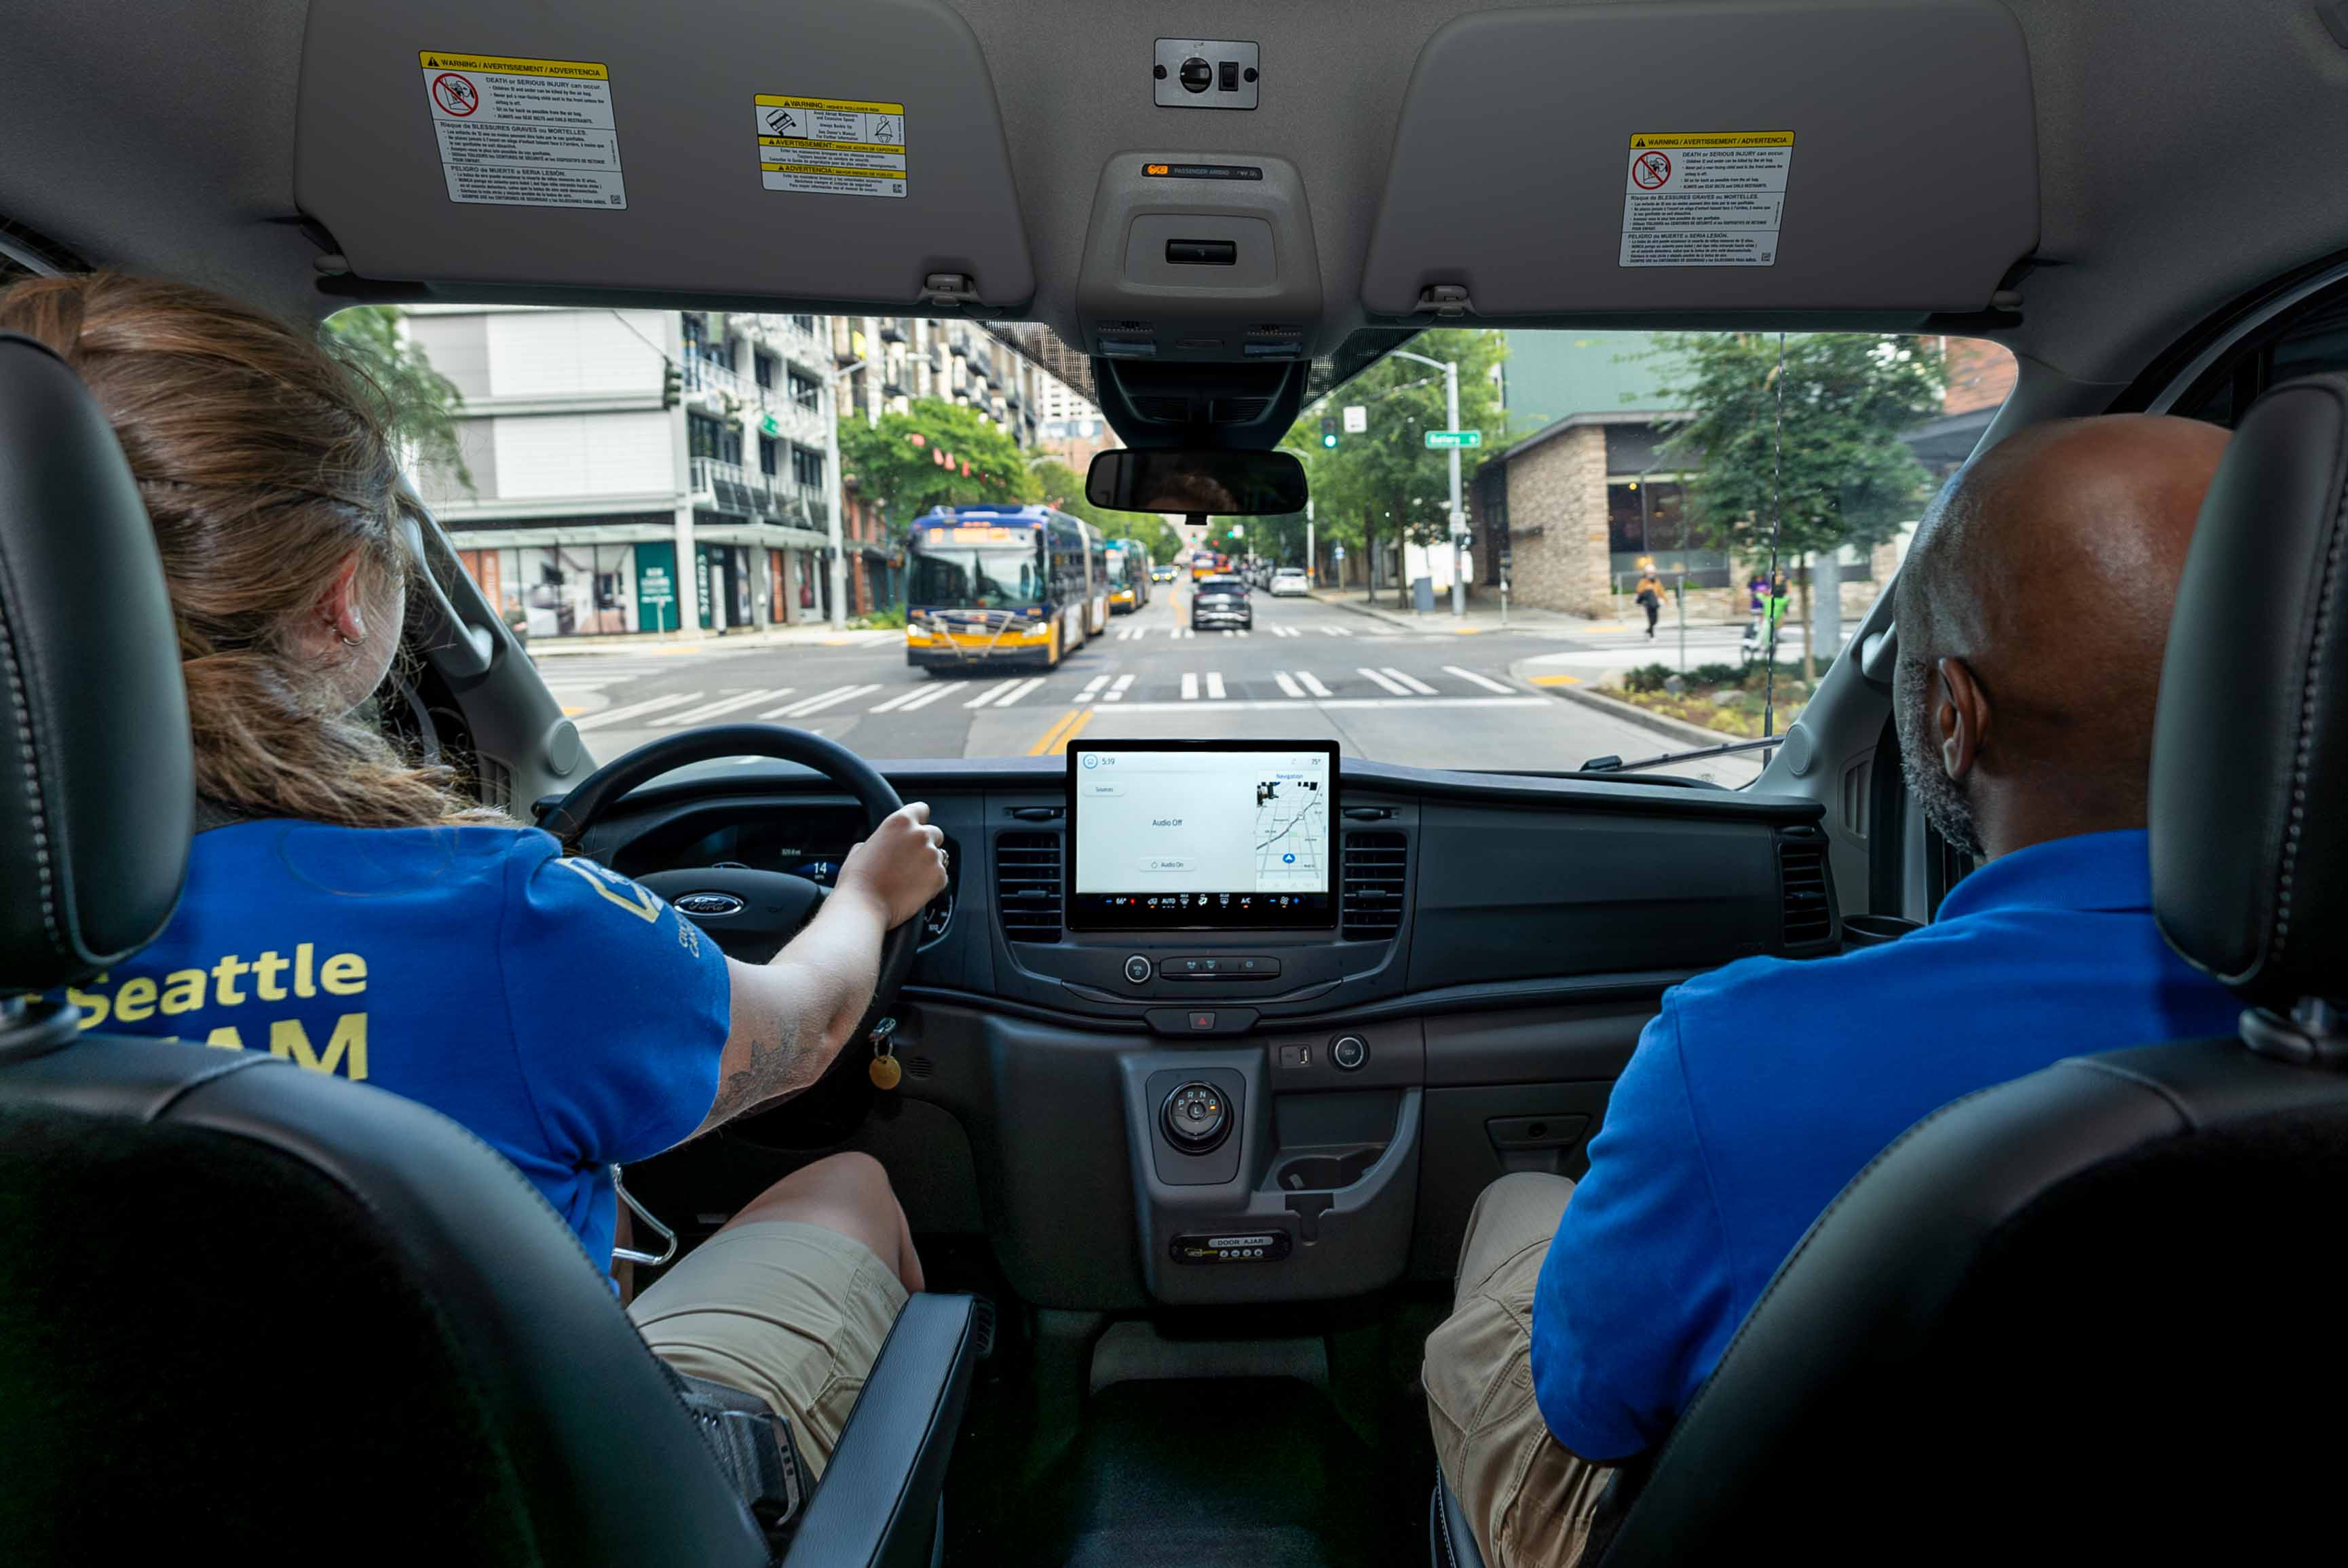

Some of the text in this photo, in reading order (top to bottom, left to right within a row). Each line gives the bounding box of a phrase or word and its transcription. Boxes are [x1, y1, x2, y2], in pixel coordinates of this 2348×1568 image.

[441, 59, 477, 69] WARNING
[483, 62, 543, 73] AVERTISSEMENT
[550, 66, 601, 76] ADVERTENCIA
[814, 862, 827, 874] 14
[67, 942, 367, 1031] Seattle
